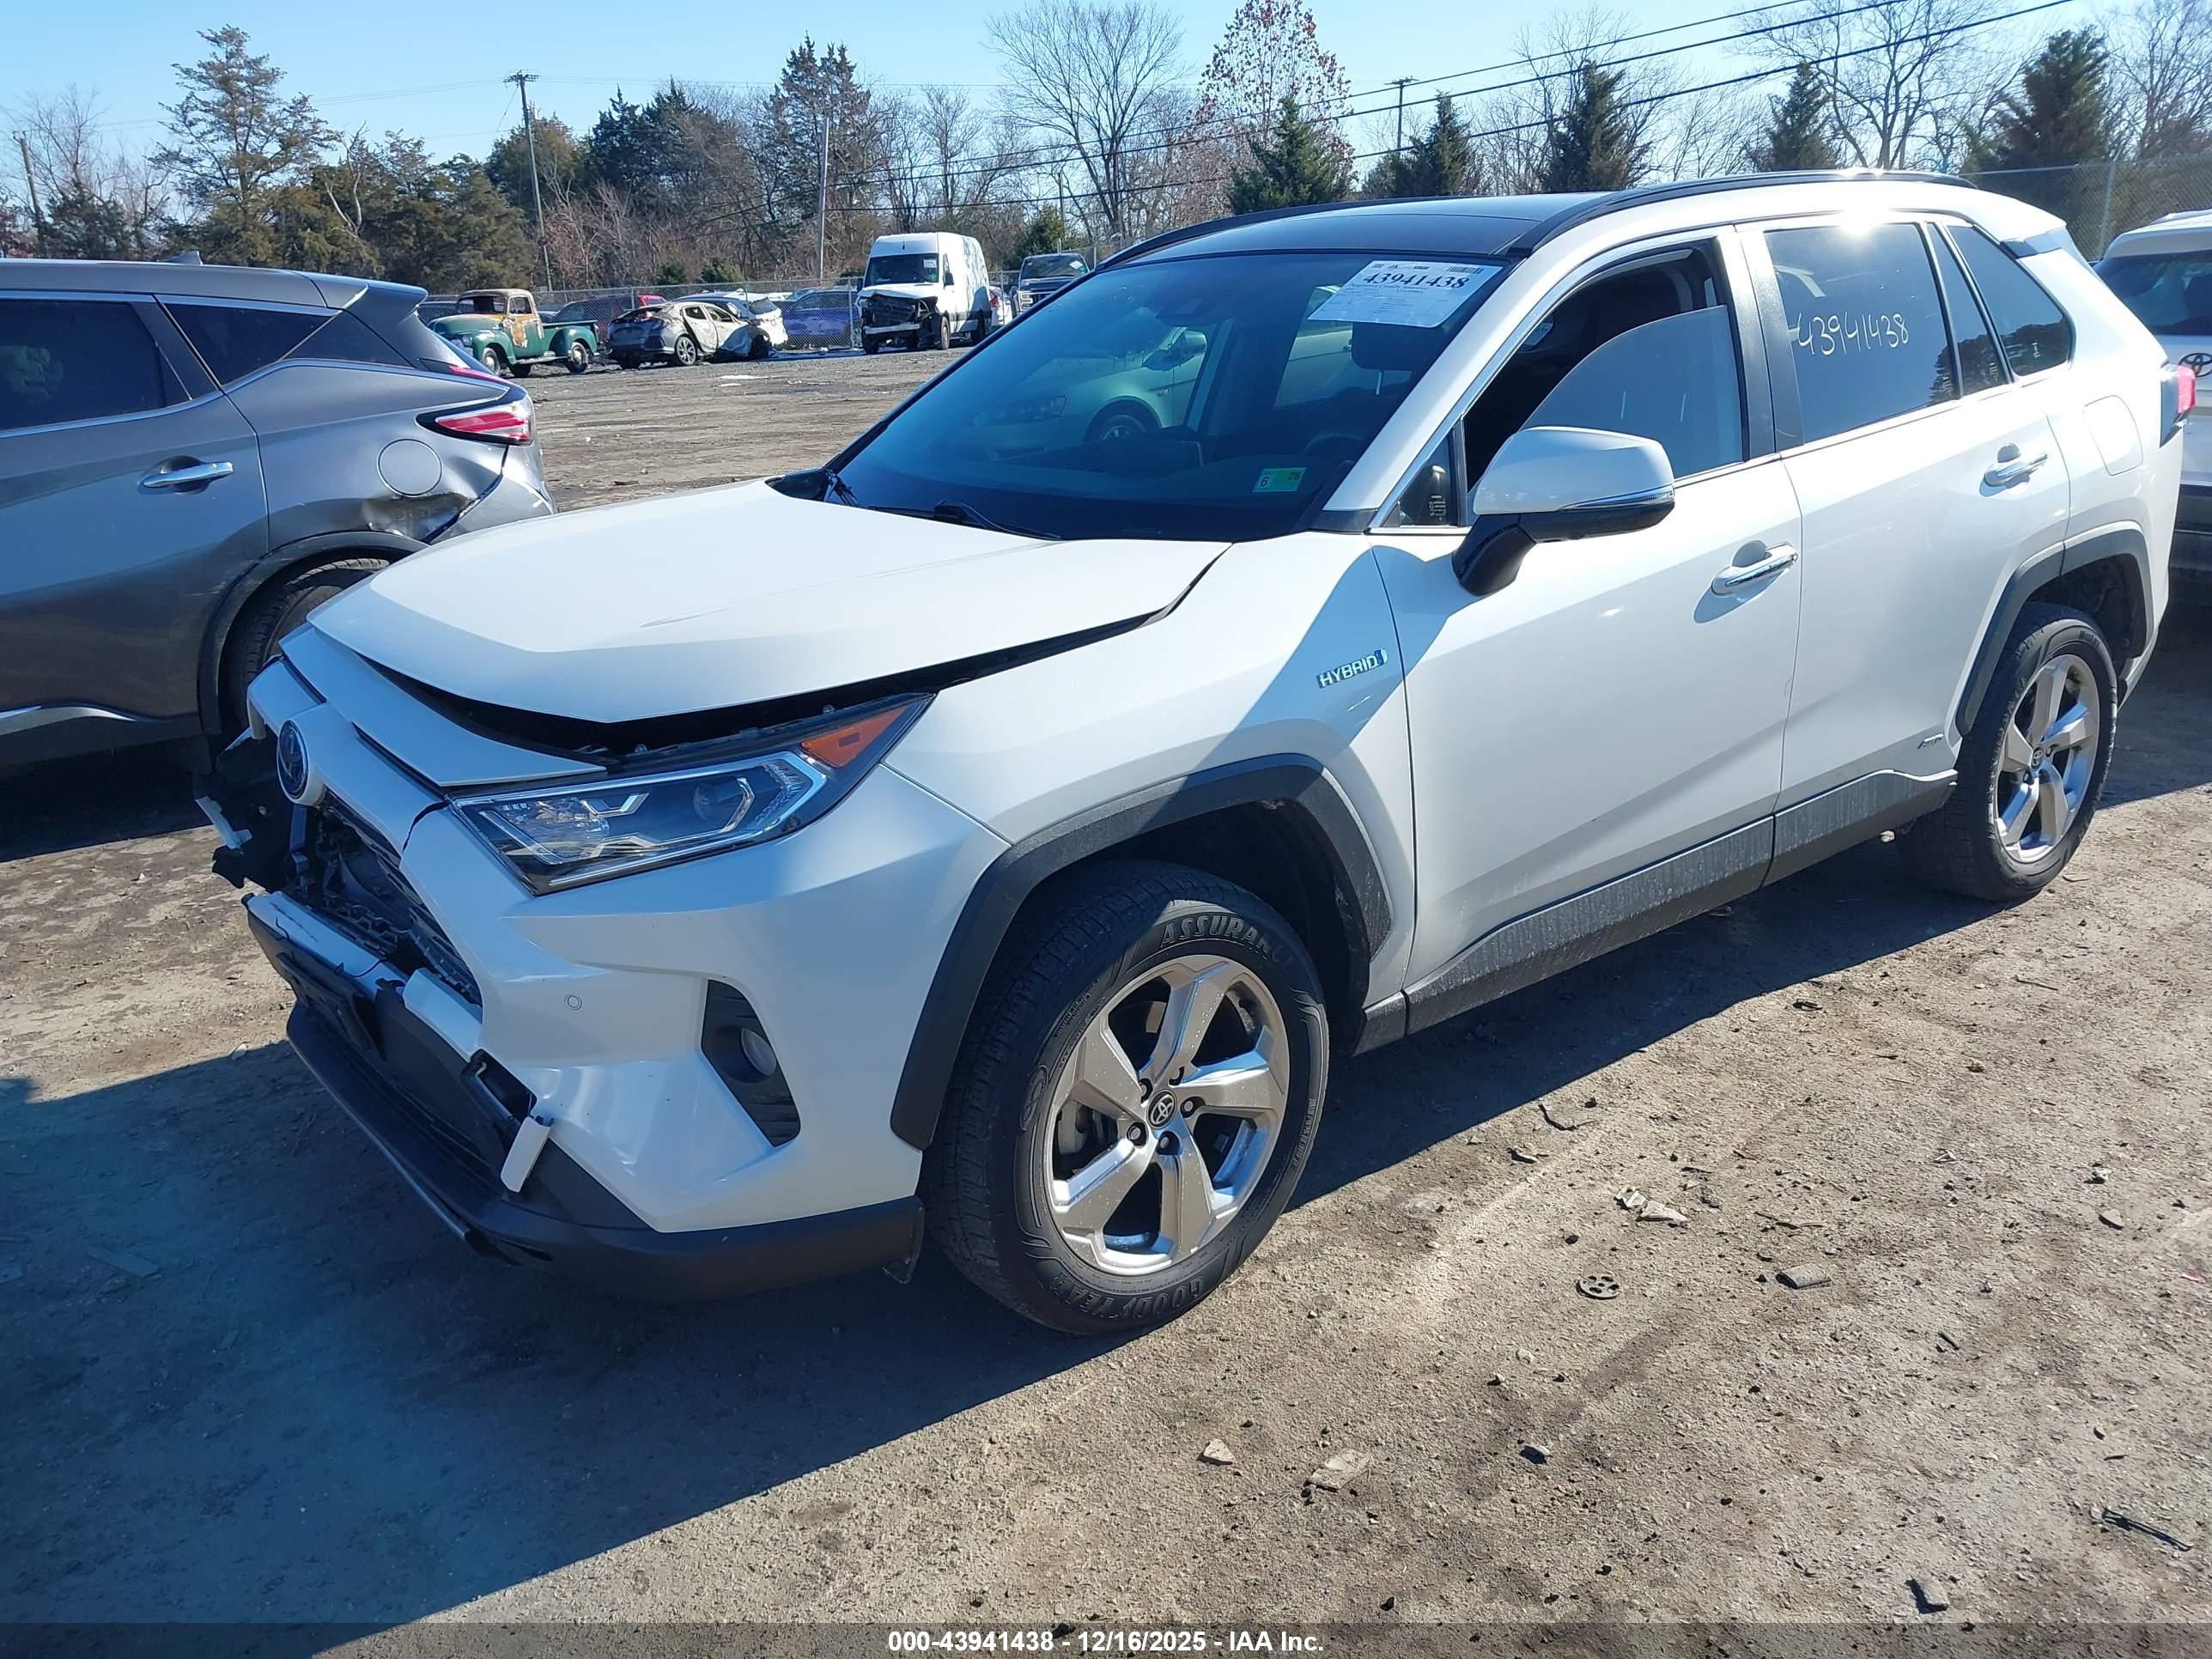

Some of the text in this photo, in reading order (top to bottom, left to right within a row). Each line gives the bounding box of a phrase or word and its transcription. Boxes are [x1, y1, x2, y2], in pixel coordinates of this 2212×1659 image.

[1363, 272, 1470, 289] 43941438
[1796, 311, 1910, 356] 43941438
[1260, 476, 1269, 487] 6
[1317, 654, 1378, 688] HYBRID
